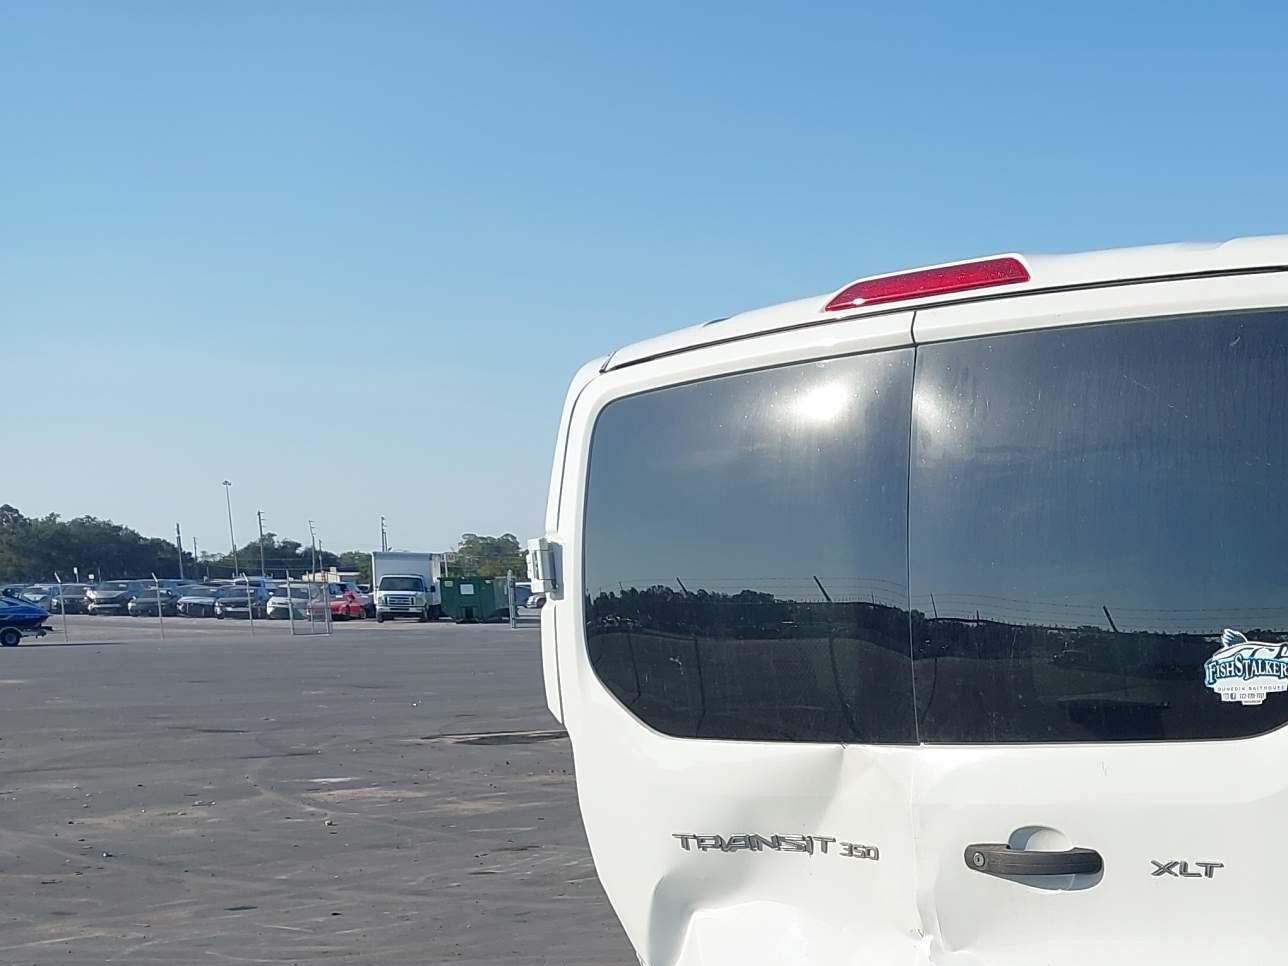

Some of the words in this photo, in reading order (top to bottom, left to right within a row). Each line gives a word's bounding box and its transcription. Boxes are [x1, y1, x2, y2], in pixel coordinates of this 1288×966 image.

[672, 833, 836, 856] TRANSIT
[839, 841, 880, 861] 350
[1150, 860, 1225, 879] XLT
